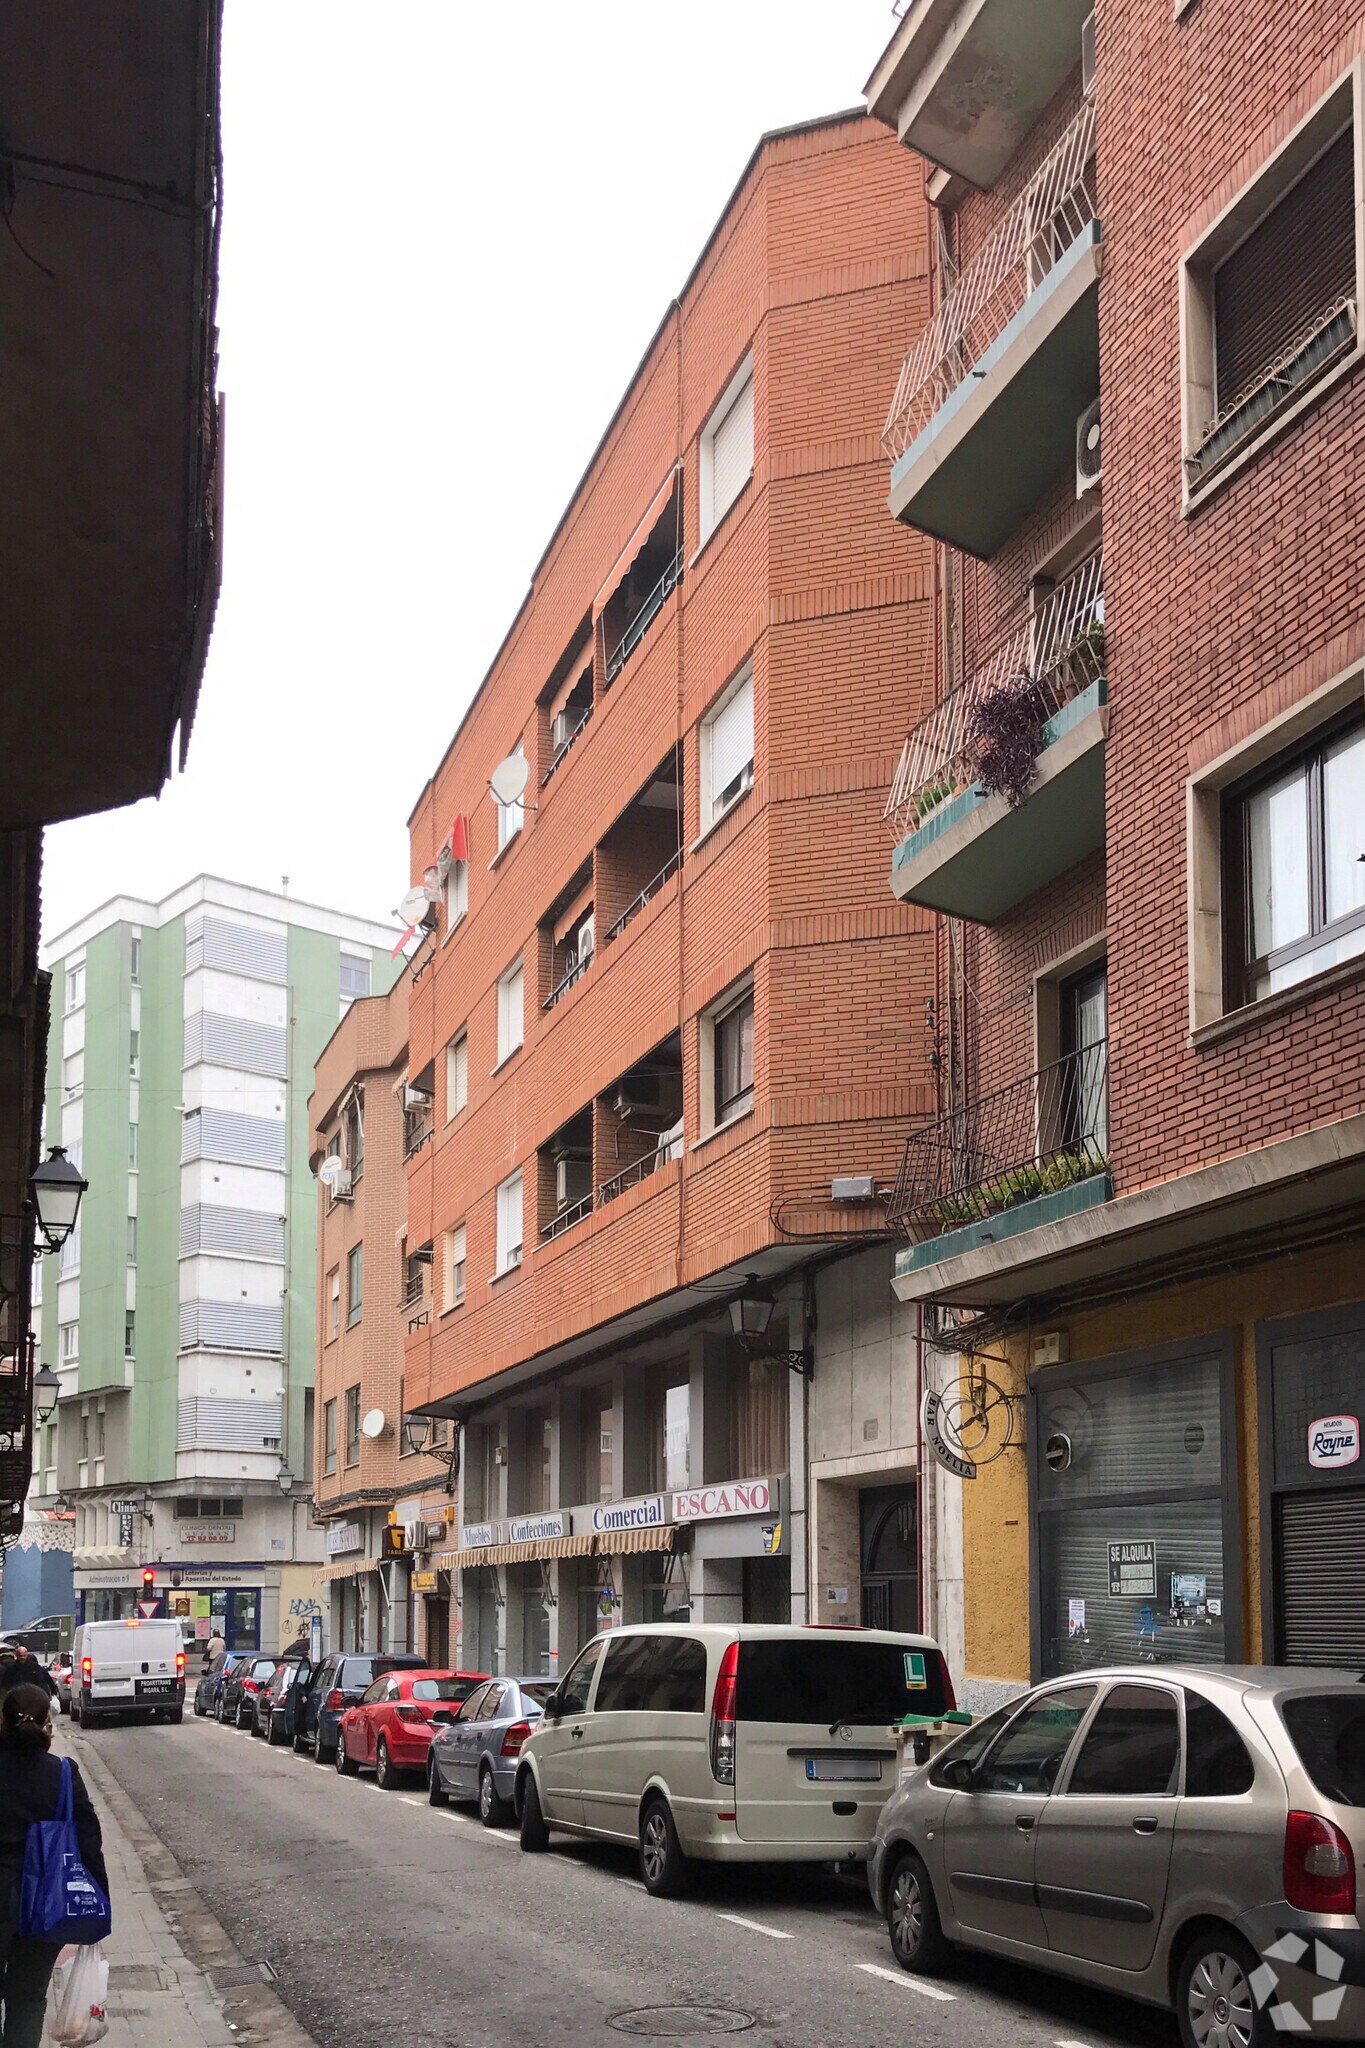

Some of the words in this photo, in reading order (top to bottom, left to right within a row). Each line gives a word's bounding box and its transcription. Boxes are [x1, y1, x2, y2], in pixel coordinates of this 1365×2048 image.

[926, 1397, 937, 1426] BAR
[932, 1436, 973, 1475] NOELIA
[1312, 1432, 1355, 1458] Royne
[593, 1497, 662, 1530] Comercial
[675, 1484, 770, 1518] ESCAÑO
[465, 1529, 491, 1546] Muebles
[511, 1518, 562, 1542] Confecciones
[1110, 1546, 1121, 1562] SE
[1121, 1544, 1153, 1562] ALQUILA
[906, 1654, 924, 1681] L
